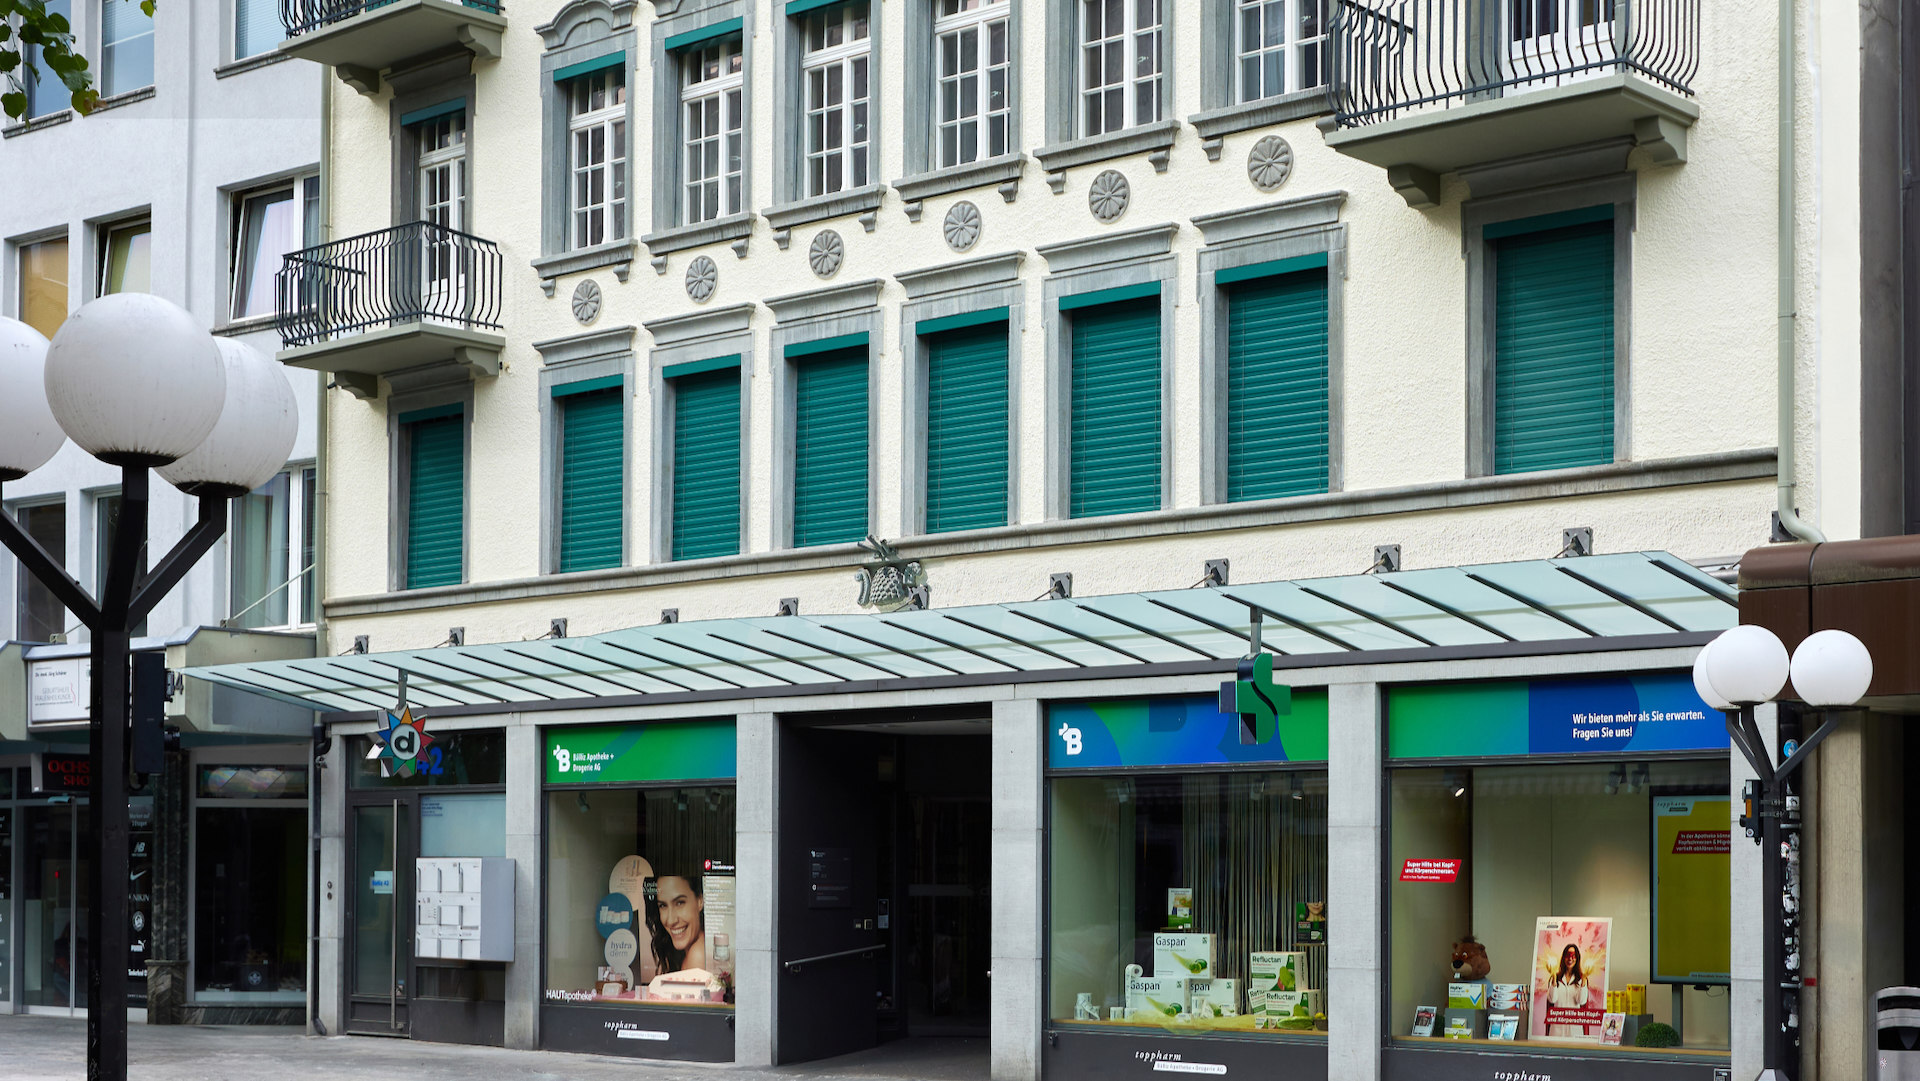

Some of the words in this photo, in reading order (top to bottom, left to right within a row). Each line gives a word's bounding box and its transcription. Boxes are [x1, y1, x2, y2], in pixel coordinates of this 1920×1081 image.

[1573, 713, 1586, 724] Wir
[1588, 712, 1613, 724] bieten
[1616, 711, 1637, 723] mehr
[1638, 710, 1650, 721] als
[1651, 710, 1664, 721] Sie
[1666, 710, 1705, 720] erwarten.
[1573, 728, 1600, 741] Fragen
[1601, 727, 1613, 738] Sie
[1615, 726, 1633, 737] uns!
[587, 752, 609, 762] Apotheke
[573, 764, 593, 773] Drogerie
[594, 763, 601, 771] AG
[611, 941, 632, 950] hydra
[1156, 936, 1186, 949] Gaspan
[1131, 980, 1160, 992] Gaspan
[604, 1021, 638, 1030] toppharm
[1135, 1050, 1182, 1062] toppharm
[1494, 1070, 1551, 1081] toppharm
